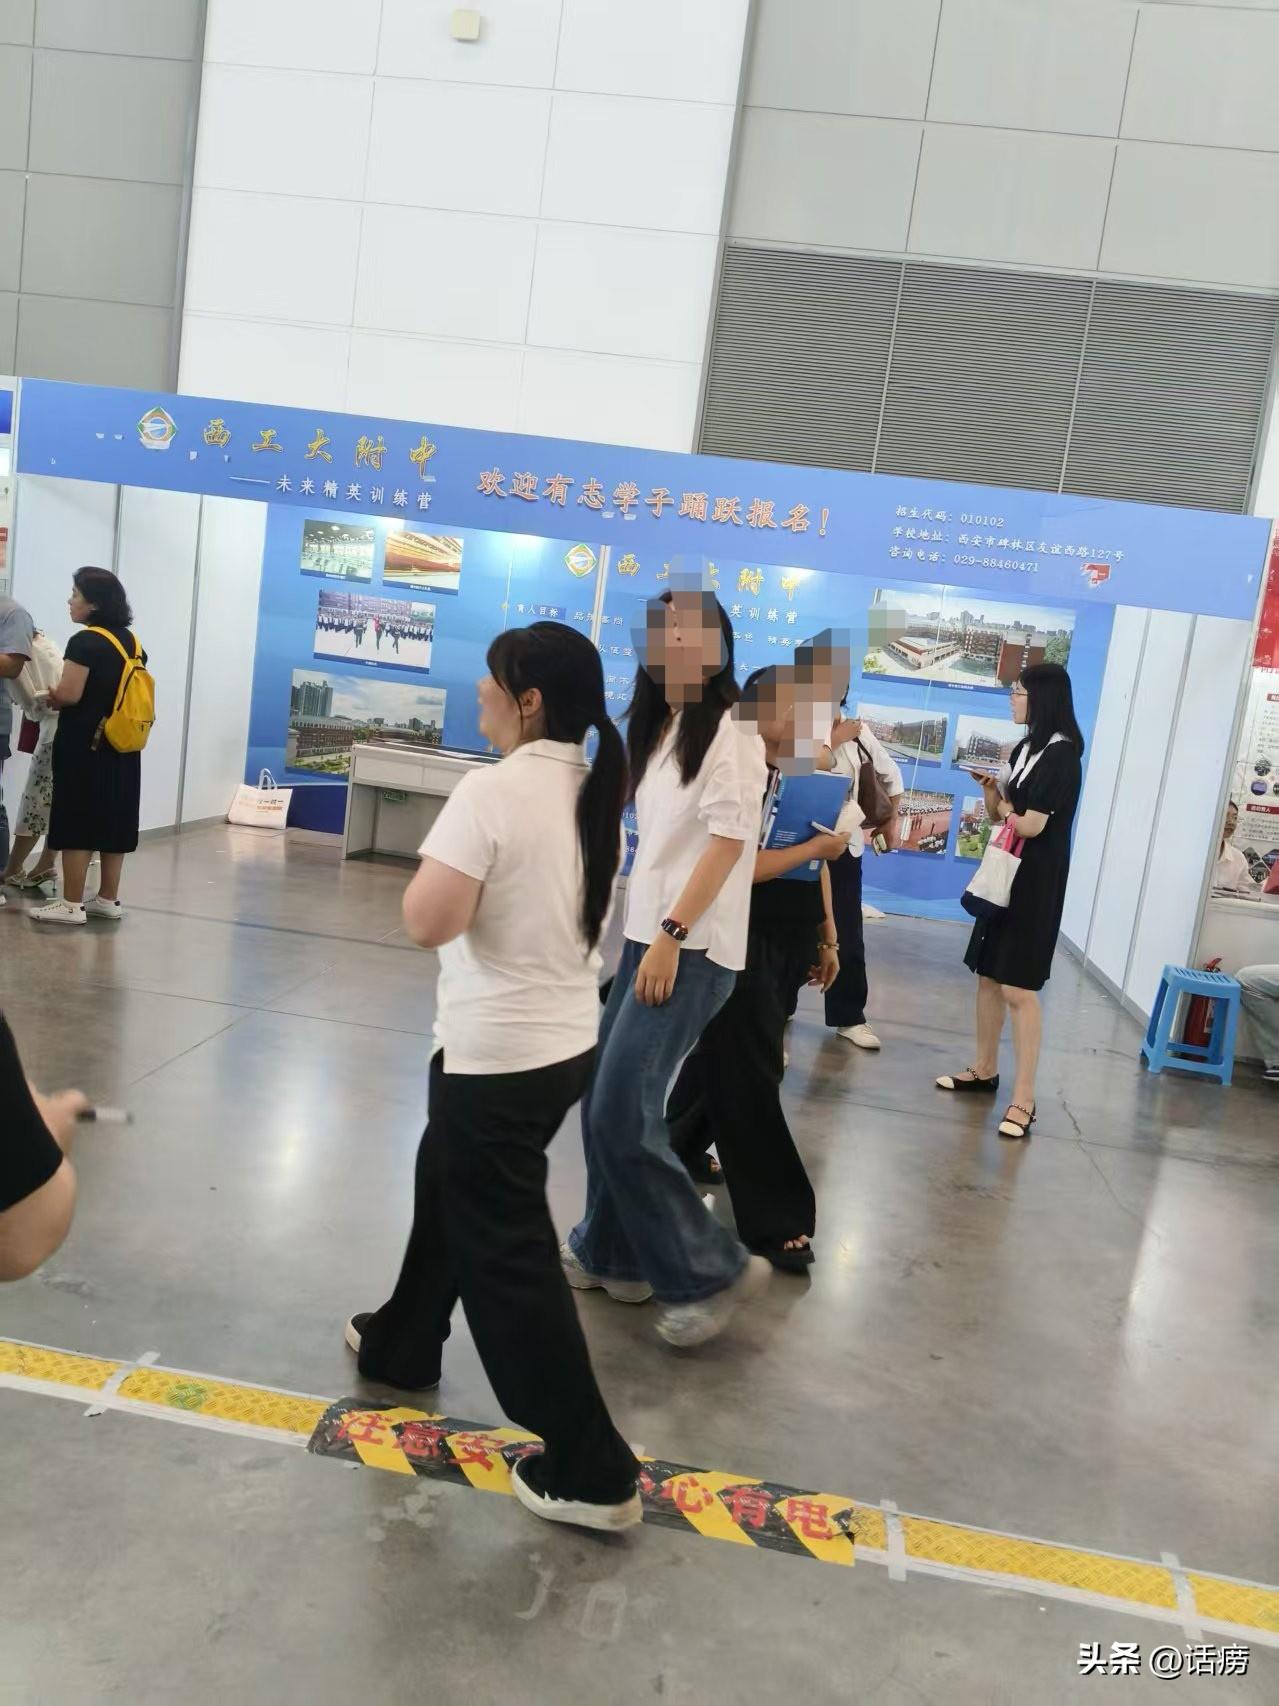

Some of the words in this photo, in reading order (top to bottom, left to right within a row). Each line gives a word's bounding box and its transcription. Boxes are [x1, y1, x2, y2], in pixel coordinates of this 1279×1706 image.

[202, 418, 439, 479] 西工大附中
[476, 466, 831, 537] 欢迎有志学子踊跃报名！
